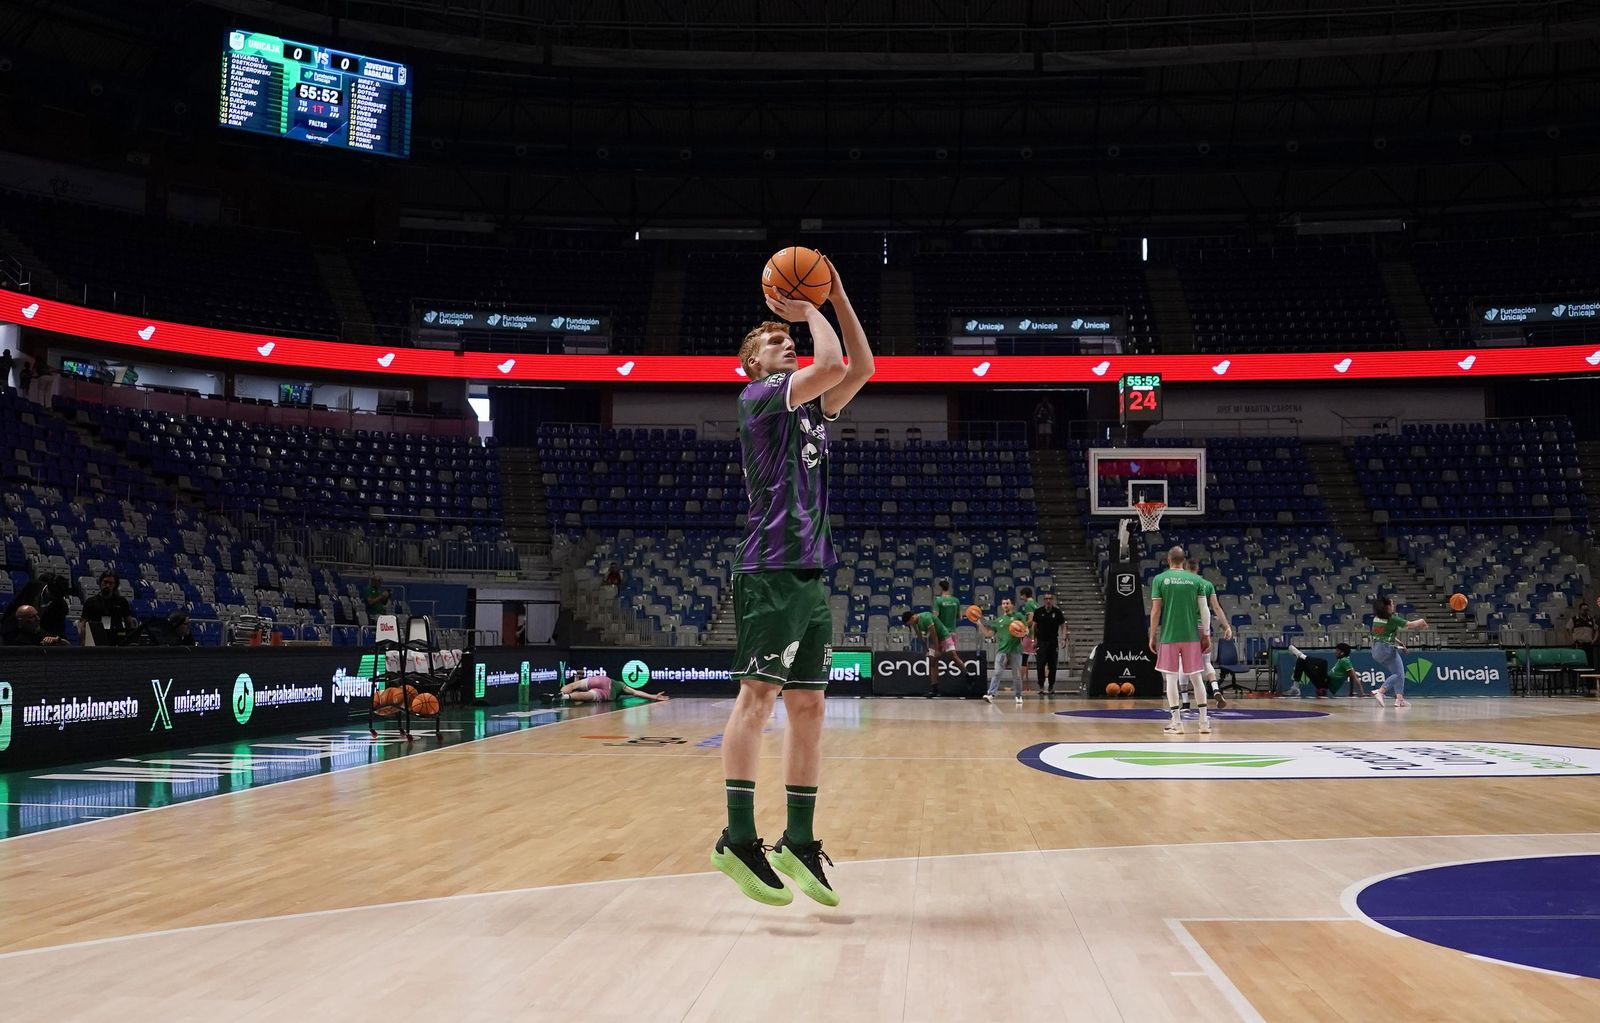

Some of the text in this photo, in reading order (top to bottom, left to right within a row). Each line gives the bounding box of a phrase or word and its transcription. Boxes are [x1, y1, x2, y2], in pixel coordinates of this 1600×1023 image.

[248, 39, 280, 53] UNICAJA
[293, 48, 350, 70] 0 VS 0
[231, 81, 252, 89] TAYLOR
[299, 84, 339, 104] 55:52
[308, 119, 327, 128] FALTAS
[1500, 307, 1536, 315] Fundación
[1568, 303, 1600, 311] Fundació
[439, 312, 474, 320] Fundación
[502, 314, 536, 323] Fundación
[1500, 314, 1527, 322] Unicaja
[1568, 310, 1595, 318] Unicaja
[439, 318, 464, 327] Unicaja
[502, 320, 528, 329] Unicaja
[566, 317, 600, 326] Fundación
[1084, 321, 1110, 330] Unicaja
[566, 323, 591, 331] Unicaja
[978, 322, 1005, 332] Unicaja
[1031, 322, 1058, 331] Unicaja
[1127, 375, 1160, 386] 55:52
[1129, 391, 1157, 410] 24
[1105, 650, 1151, 662] Andalucía
[878, 656, 980, 676] endesa
[651, 668, 731, 682] unicajabalonc
[1436, 666, 1500, 684] Unicaja
[23, 696, 138, 730] unicajabaloncesto
[174, 688, 221, 716] unicajacb
[254, 684, 323, 708] unicajabaloncesto
